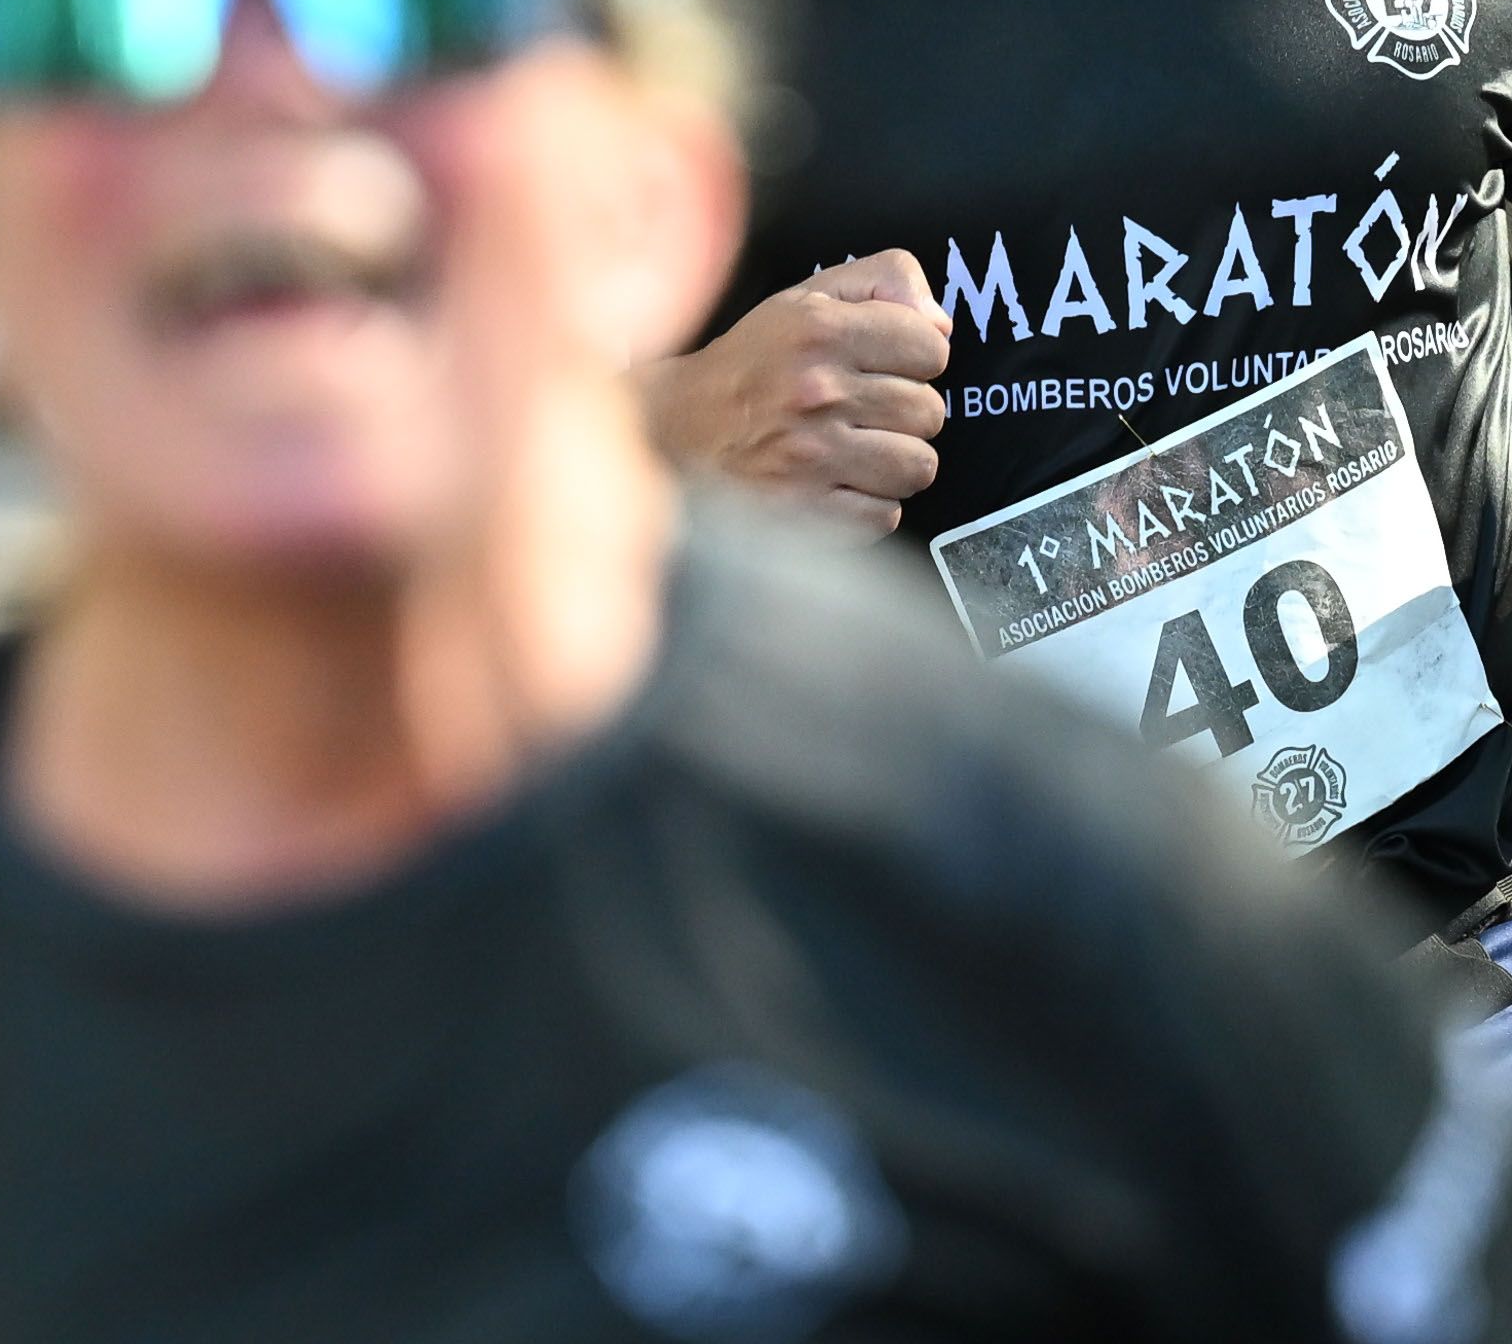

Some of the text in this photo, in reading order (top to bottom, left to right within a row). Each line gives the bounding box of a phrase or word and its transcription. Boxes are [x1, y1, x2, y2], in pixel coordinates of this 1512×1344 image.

[1393, 40, 1439, 63] ROSARIO
[941, 151, 1469, 343] MARATÓN
[964, 371, 1155, 419] BOMBEROS
[1381, 319, 1470, 366] ROSARIO
[998, 439, 1399, 649] ASOCIACIÓN BOMBEROS VOLUNTARIOS ROSARIO
[1085, 404, 1342, 570] MARATÓN
[1139, 560, 1359, 758] 40
[1279, 775, 1315, 816] 27
